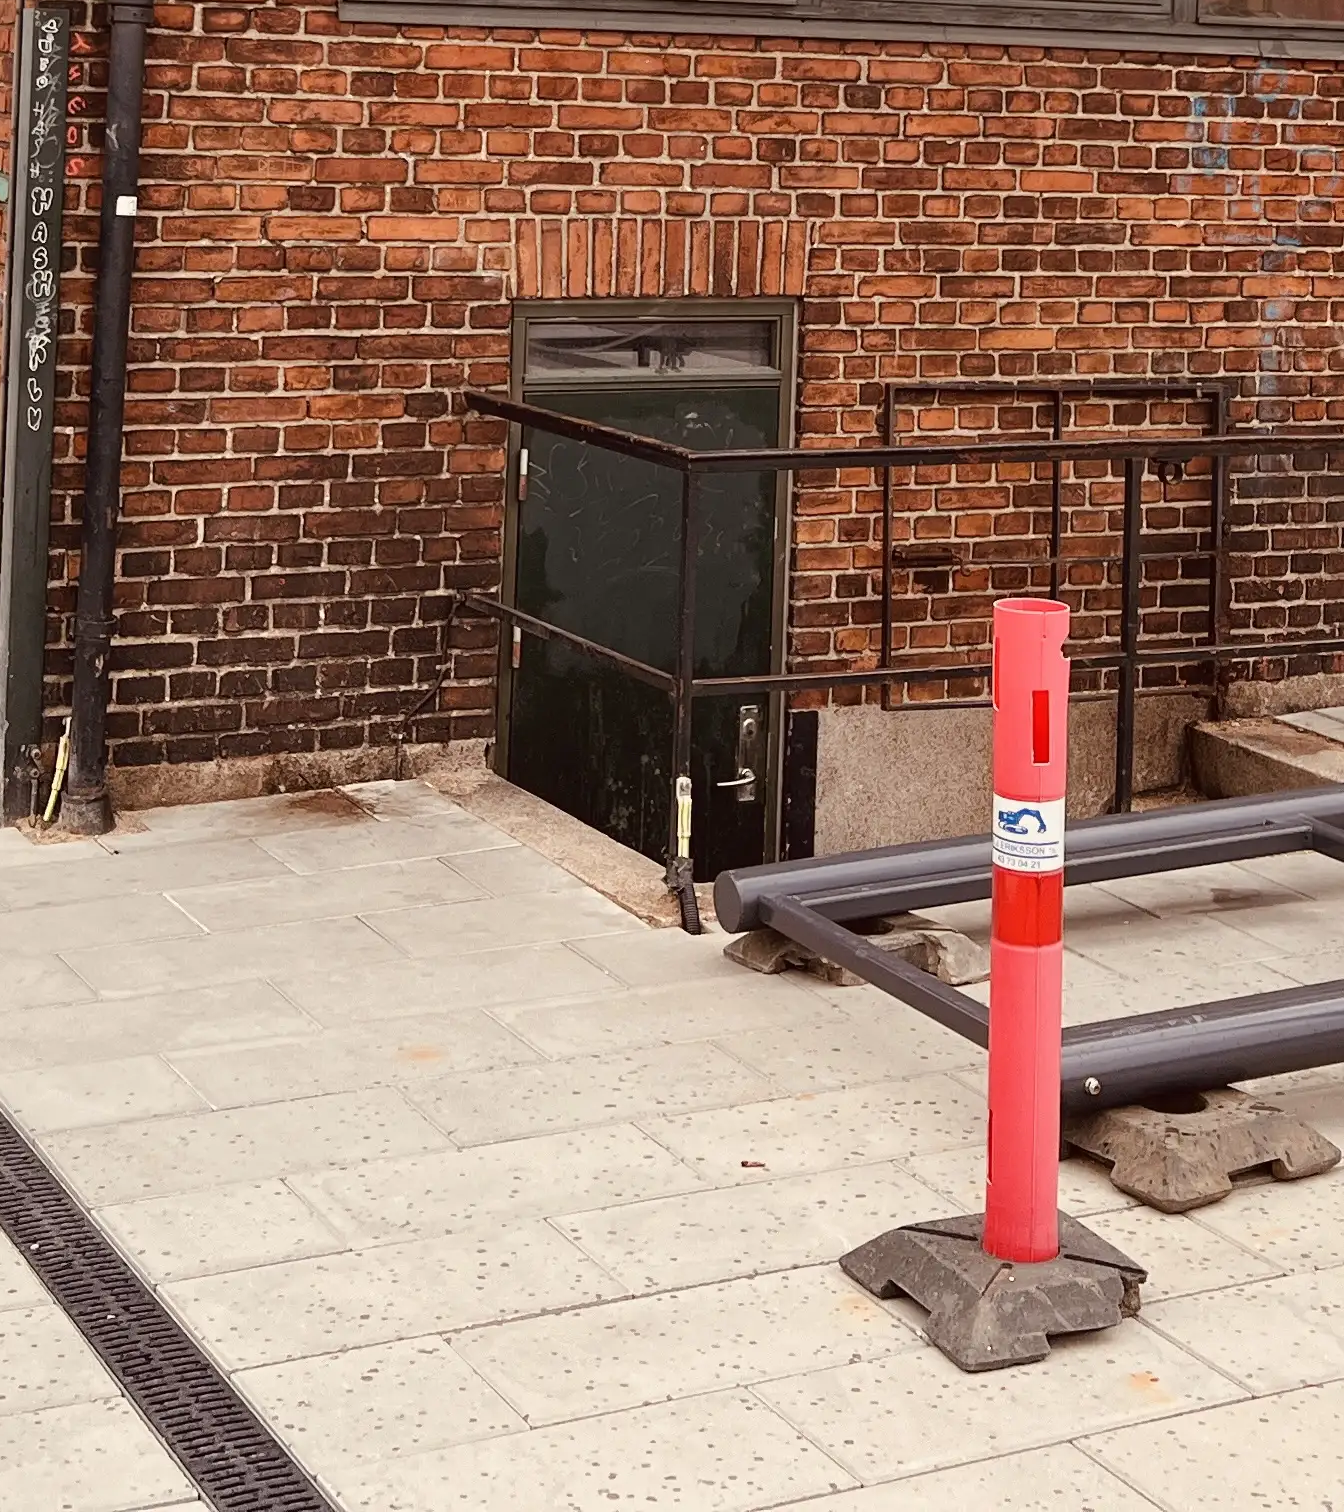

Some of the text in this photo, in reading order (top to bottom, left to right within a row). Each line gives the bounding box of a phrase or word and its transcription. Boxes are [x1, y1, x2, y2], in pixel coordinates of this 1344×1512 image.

[1000, 841, 1045, 855] ERIKSSON
[1006, 857, 1016, 865] 73
[1017, 859, 1028, 868] 04
[1030, 861, 1041, 869] 21
